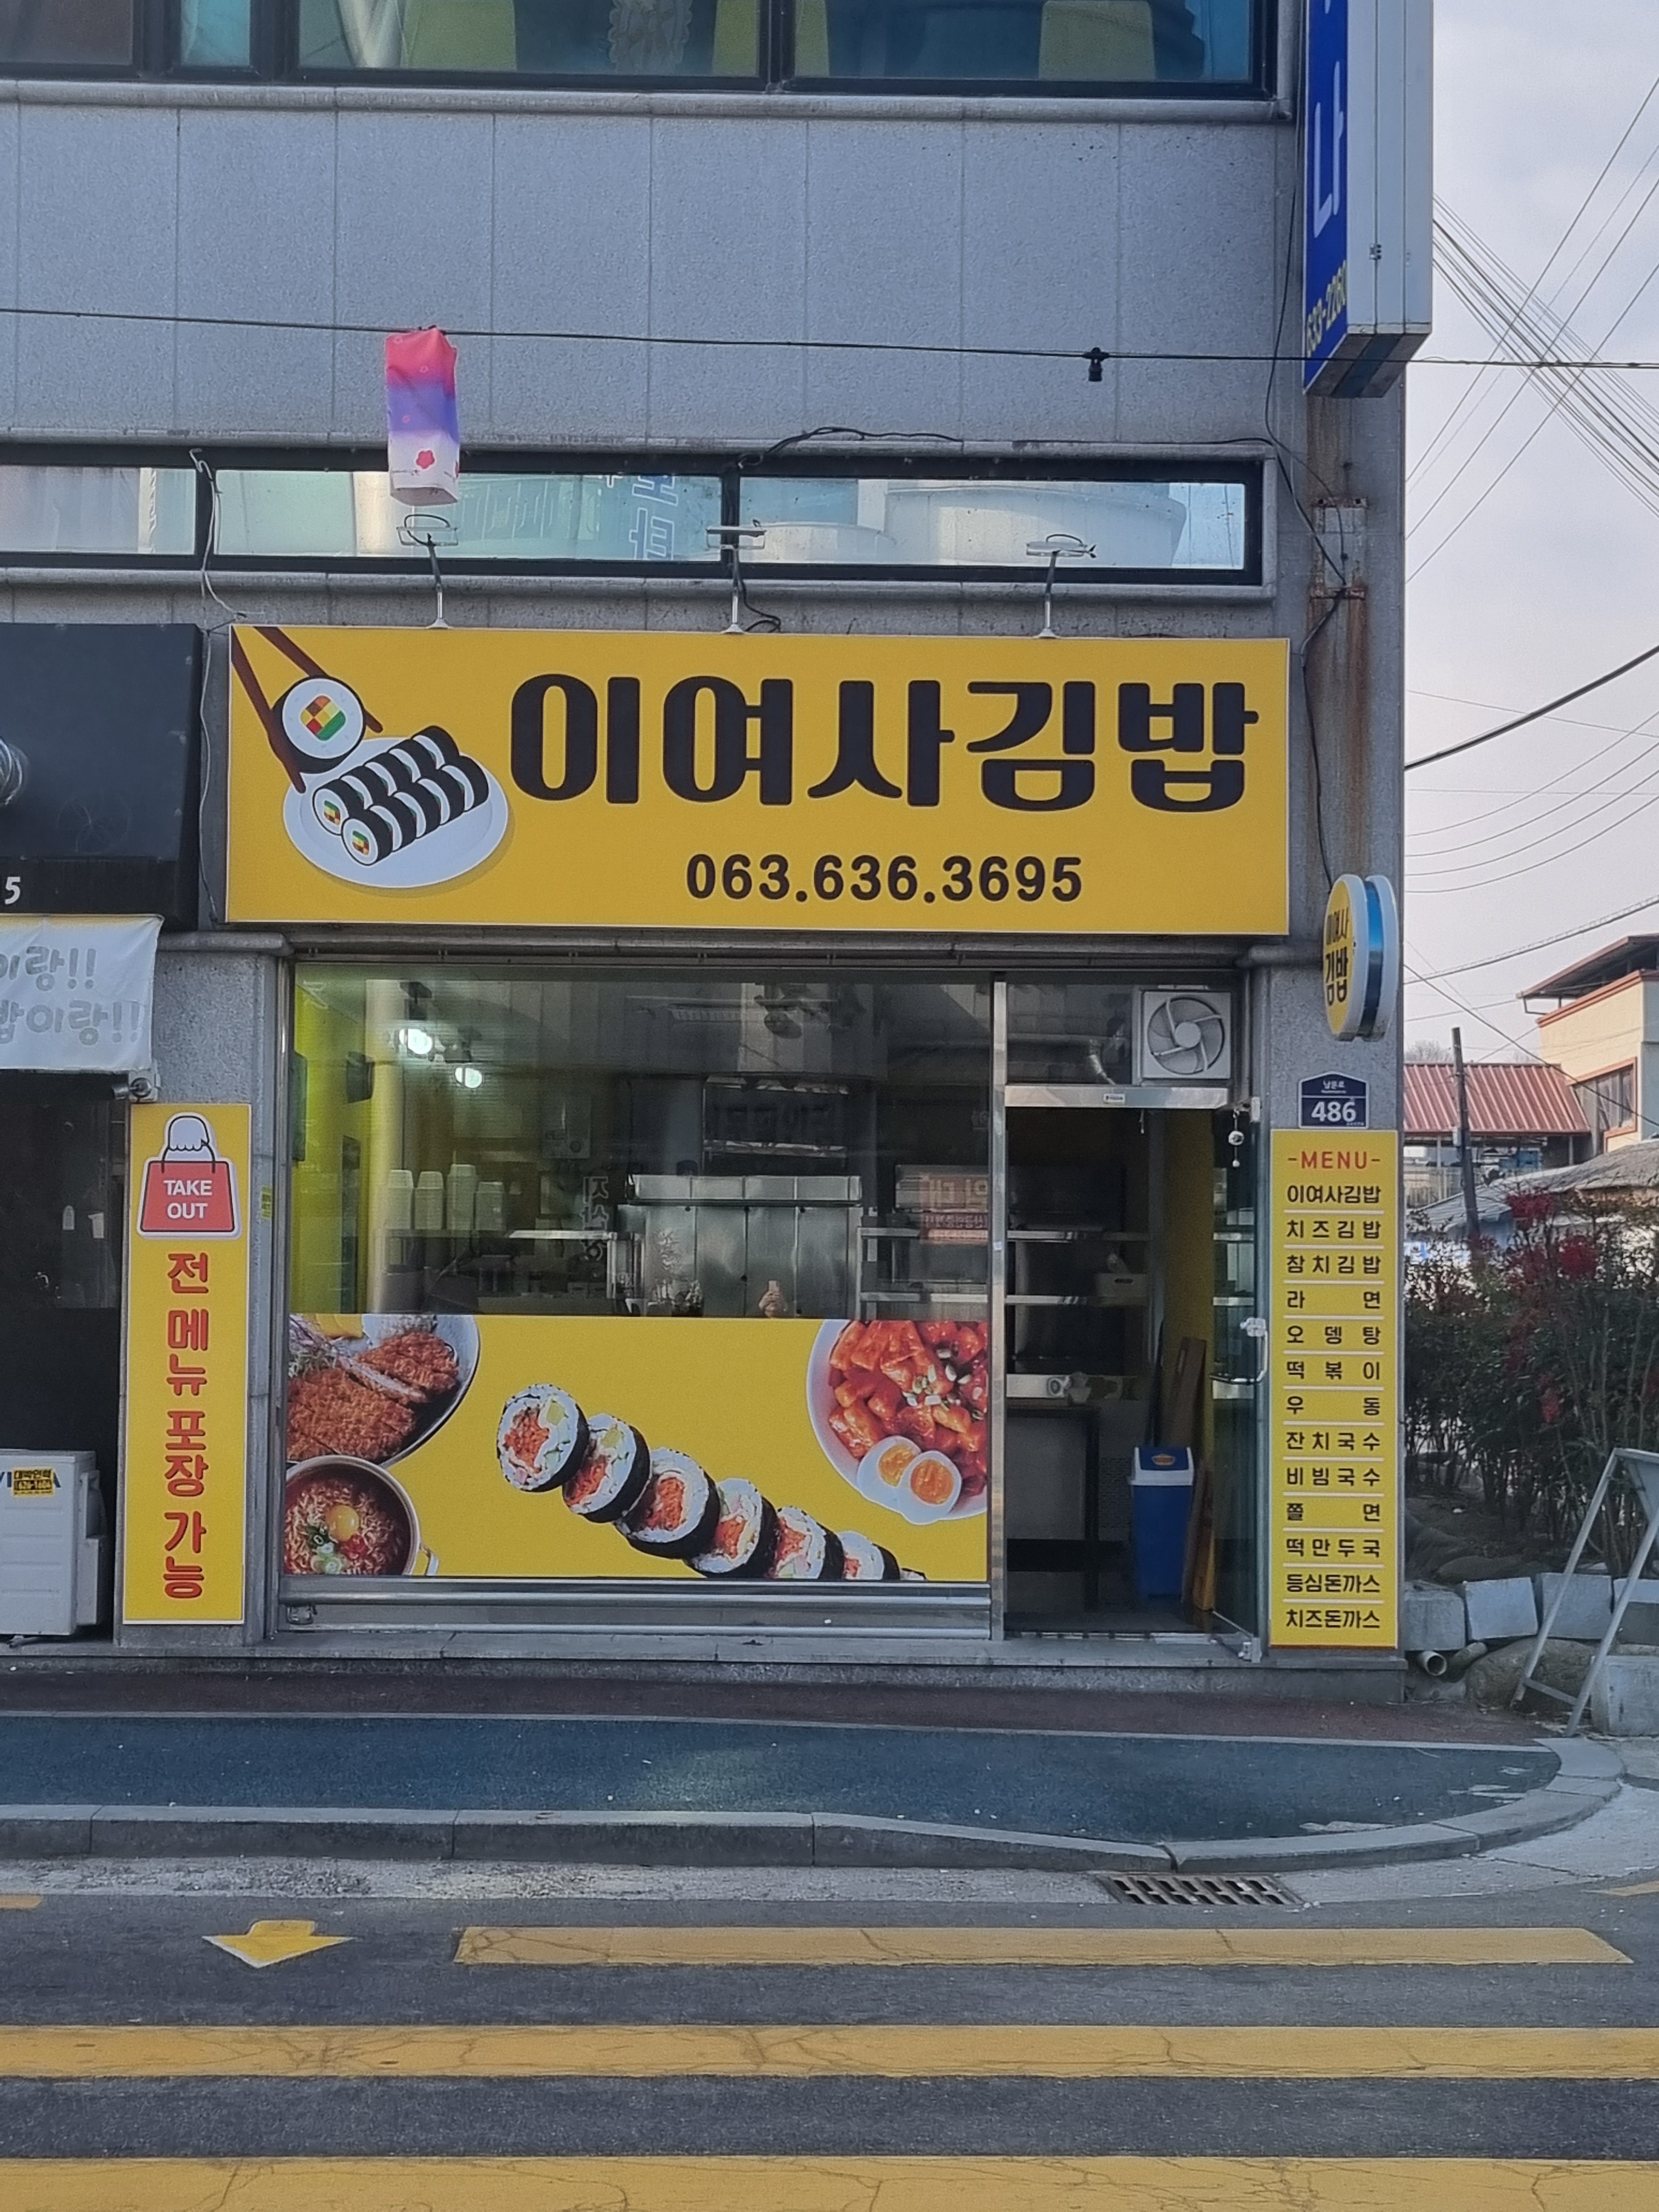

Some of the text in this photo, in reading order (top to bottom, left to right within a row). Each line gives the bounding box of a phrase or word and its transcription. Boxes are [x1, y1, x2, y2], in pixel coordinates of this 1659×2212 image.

[1313, 0, 1345, 238] 나
[511, 674, 1259, 812] 이여사김밥
[687, 854, 1081, 903] 063.636.3695
[1325, 946, 1348, 1006] 김밥
[1311, 1101, 1356, 1122] 486
[163, 1180, 213, 1196] TAKE
[1286, 1185, 1381, 1204] 이여사김밥
[167, 1202, 208, 1219] OUT
[1286, 1220, 1381, 1239] 치즈김밥
[1286, 1255, 1381, 1274] 참치김밥
[163, 1252, 209, 1599] 전 메뉴 포장 가능
[1286, 1431, 1381, 1451] 잔치국수
[1286, 1467, 1381, 1487] 비빔국수
[1286, 1538, 1381, 1558] 떡만두국
[1286, 1574, 1381, 1593] 등심돈까스
[1286, 1609, 1381, 1629] 치즈돈까스
